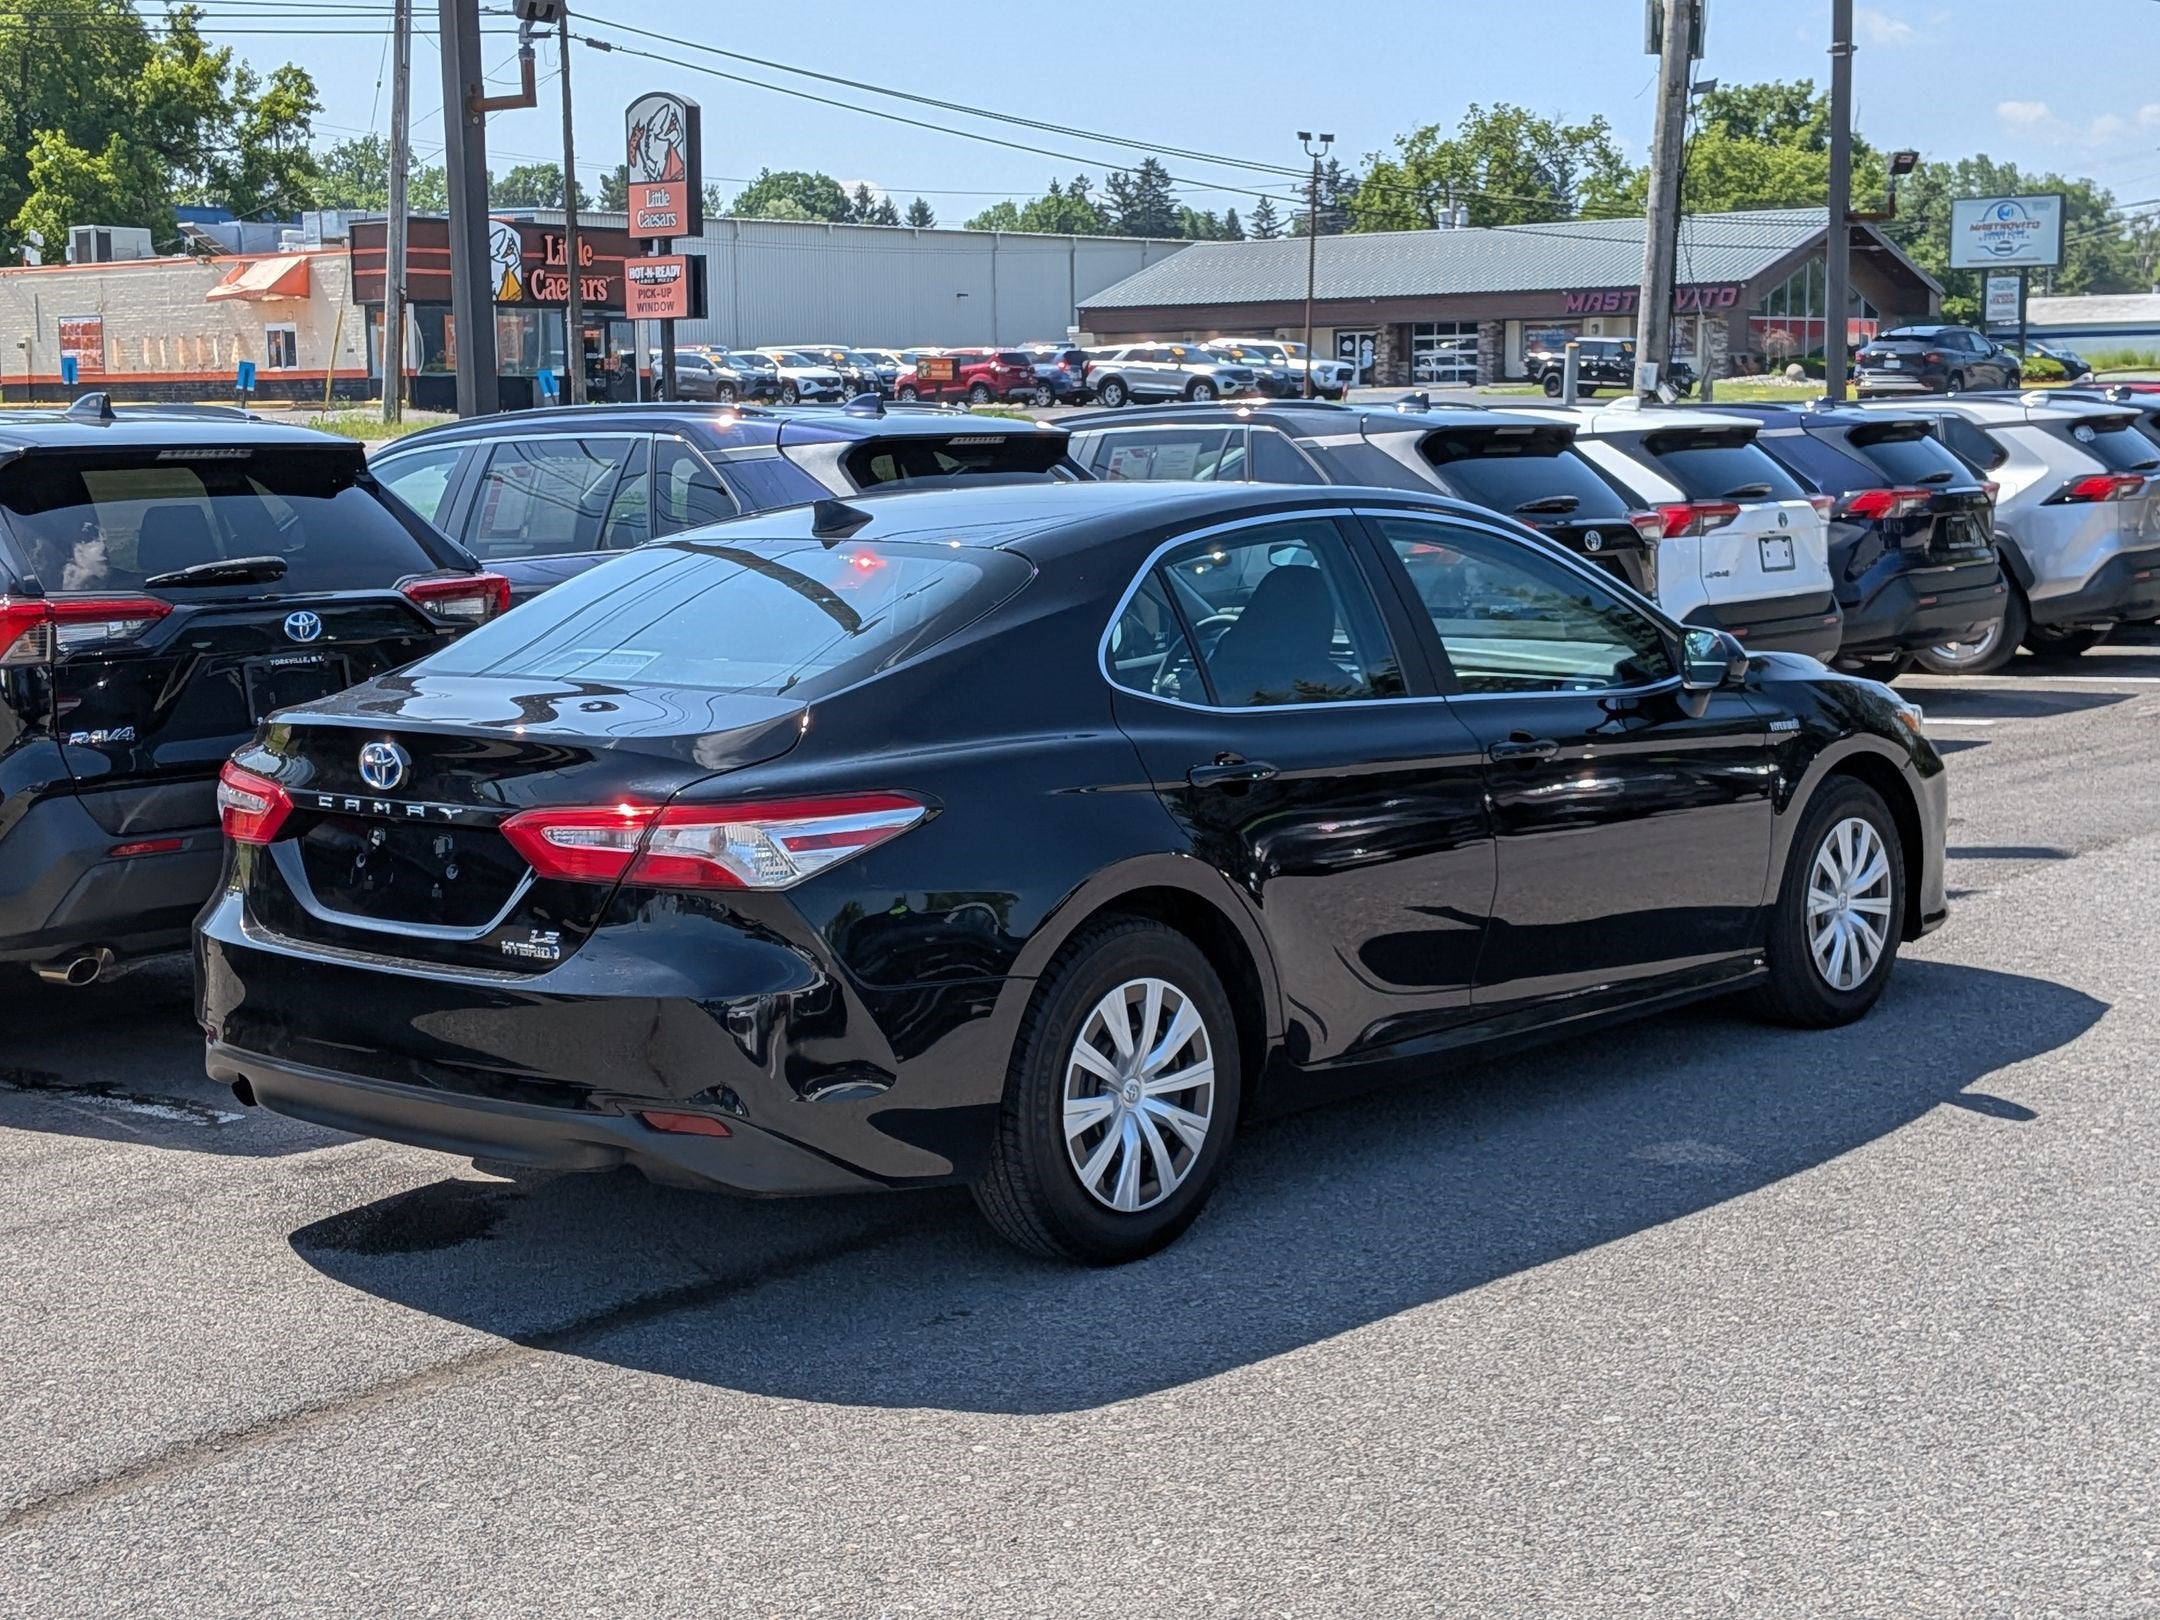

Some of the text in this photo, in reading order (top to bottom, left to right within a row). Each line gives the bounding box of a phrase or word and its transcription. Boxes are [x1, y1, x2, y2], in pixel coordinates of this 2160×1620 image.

[645, 188, 670, 207] Little
[637, 210, 677, 228] Caesars
[544, 234, 593, 267] Lile
[629, 265, 682, 280] HOT-N-READY
[531, 268, 608, 301] Caears
[638, 287, 672, 299] PICK-UP
[636, 301, 675, 313] WINDOW
[1564, 287, 1740, 313] MASTVITO
[68, 726, 135, 746] RAV4
[318, 795, 463, 820] CAMRY
